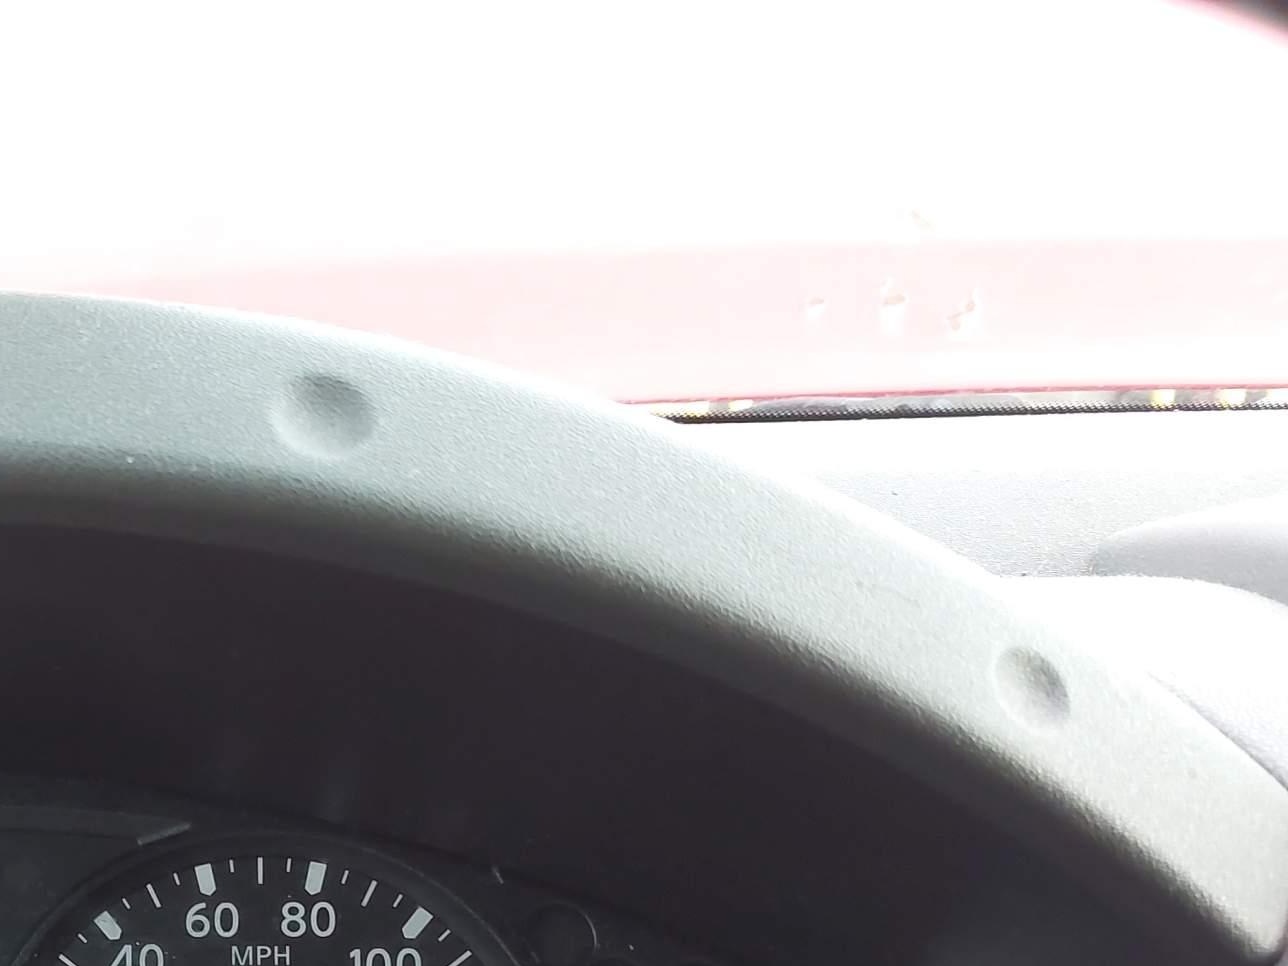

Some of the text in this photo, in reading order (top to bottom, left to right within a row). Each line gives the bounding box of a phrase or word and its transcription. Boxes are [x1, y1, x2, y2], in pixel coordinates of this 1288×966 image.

[185, 902, 239, 938] 60
[281, 902, 336, 938] 80
[231, 945, 291, 966] MPH
